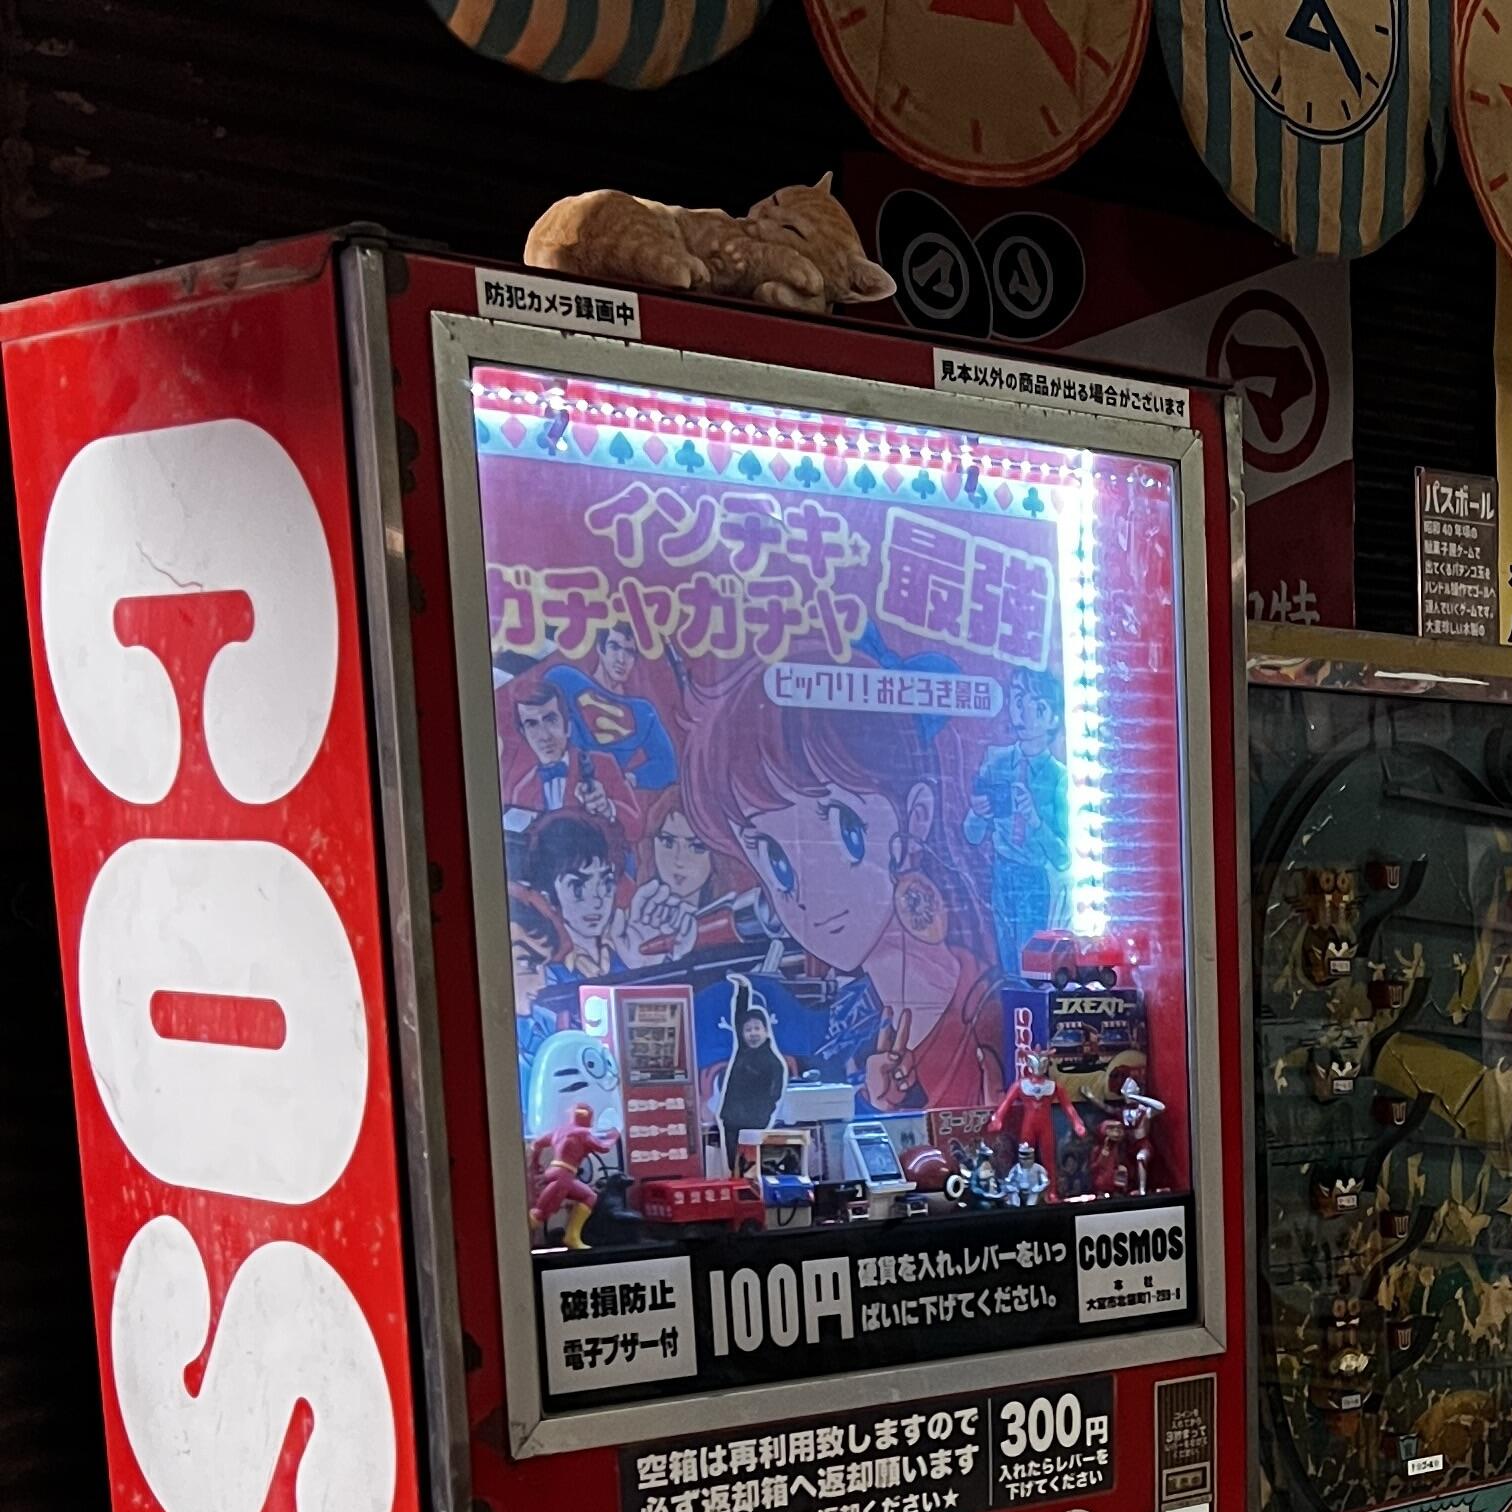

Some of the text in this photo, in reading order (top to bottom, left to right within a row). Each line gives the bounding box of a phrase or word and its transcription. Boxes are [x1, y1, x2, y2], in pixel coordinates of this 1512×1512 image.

[484, 279, 636, 328] 防犯カメラ録画中
[489, 564, 865, 663] ガチャガチャ
[1079, 1226, 1184, 1271] COSMOS
[559, 1279, 677, 1324] 破損防止
[708, 1255, 855, 1358] 100円
[562, 1329, 680, 1372] 電子ブザー付
[636, 1406, 979, 1491] 空箱は再利用致しますので
[1000, 1393, 1108, 1457] 300円
[999, 1448, 1110, 1484] 入れたらレバーを
[1005, 1468, 1104, 1502] 下げてください
